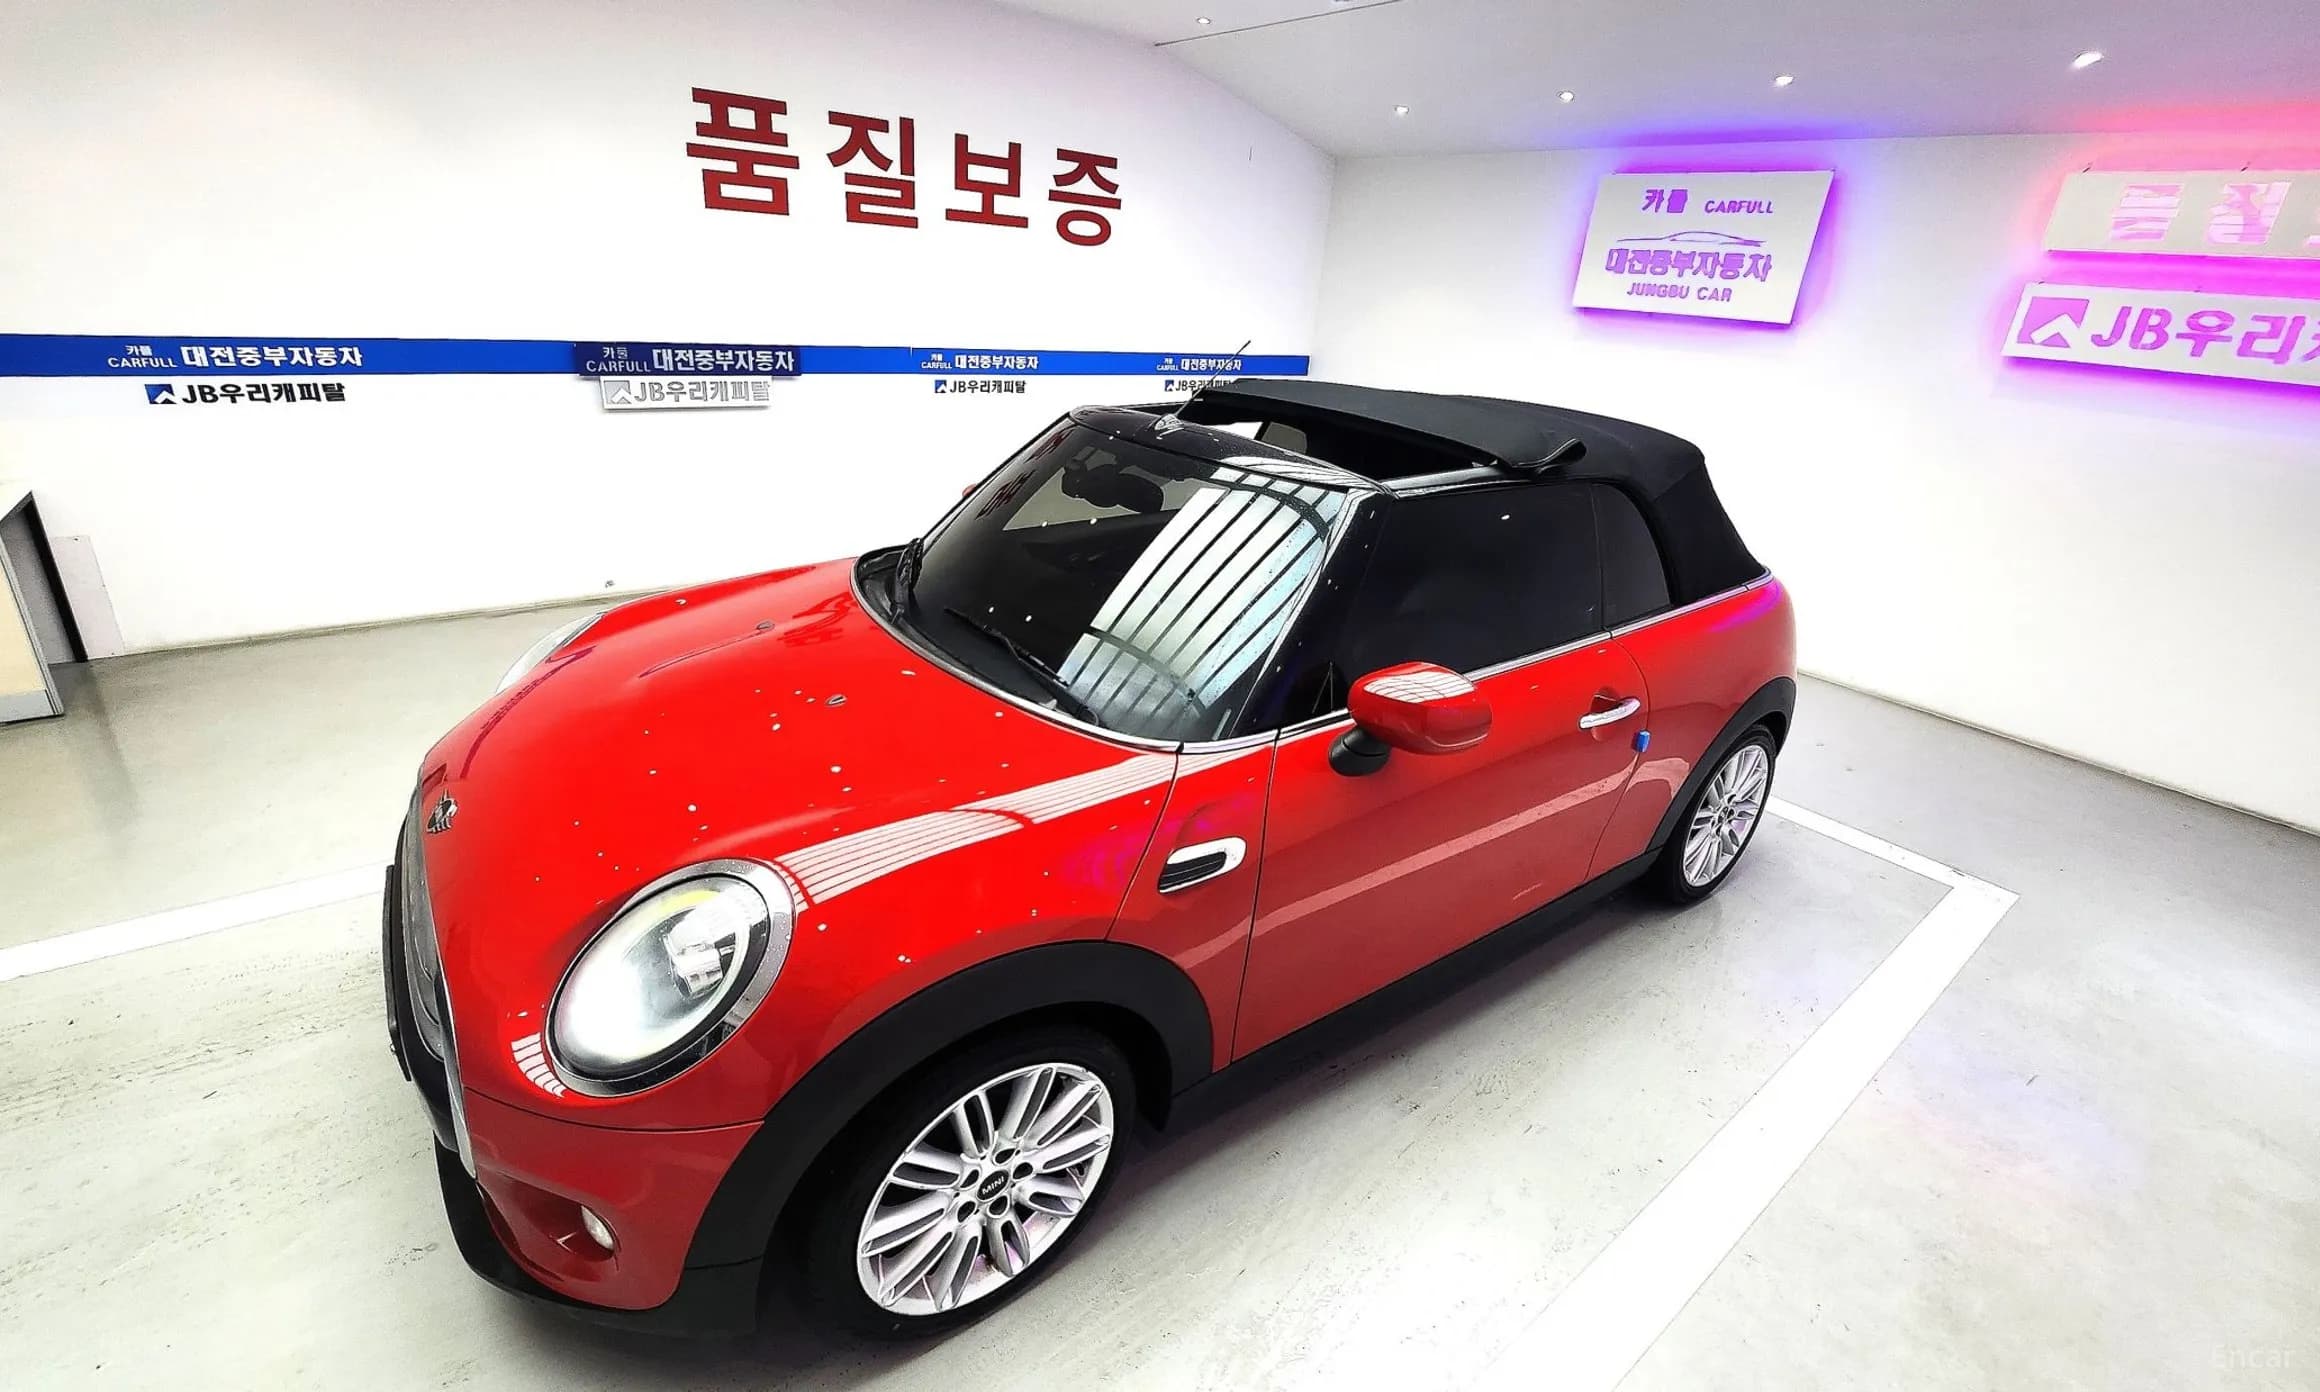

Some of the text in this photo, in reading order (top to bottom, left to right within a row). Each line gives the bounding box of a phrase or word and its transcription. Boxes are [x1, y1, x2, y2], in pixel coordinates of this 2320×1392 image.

[686, 87, 1122, 246] 품질보증
[1704, 200, 1774, 214] CARFULL
[1605, 248, 1773, 282] 대전중부자동차
[1626, 282, 1733, 302] JUNGBU CAR
[2090, 306, 2320, 364] JB우리
[107, 357, 178, 368] CARFULL
[180, 346, 363, 367] 대전중부자동차
[586, 360, 651, 372] CARFULL
[652, 348, 794, 371] 대전중부자동차
[955, 355, 1038, 369] 대전중부자동차
[182, 383, 346, 404] JB우리캐피탈
[634, 381, 770, 402] JB우리캐피탈
[950, 380, 1026, 393] JB우리캐피탈
[982, 1176, 1005, 1195] MINI
